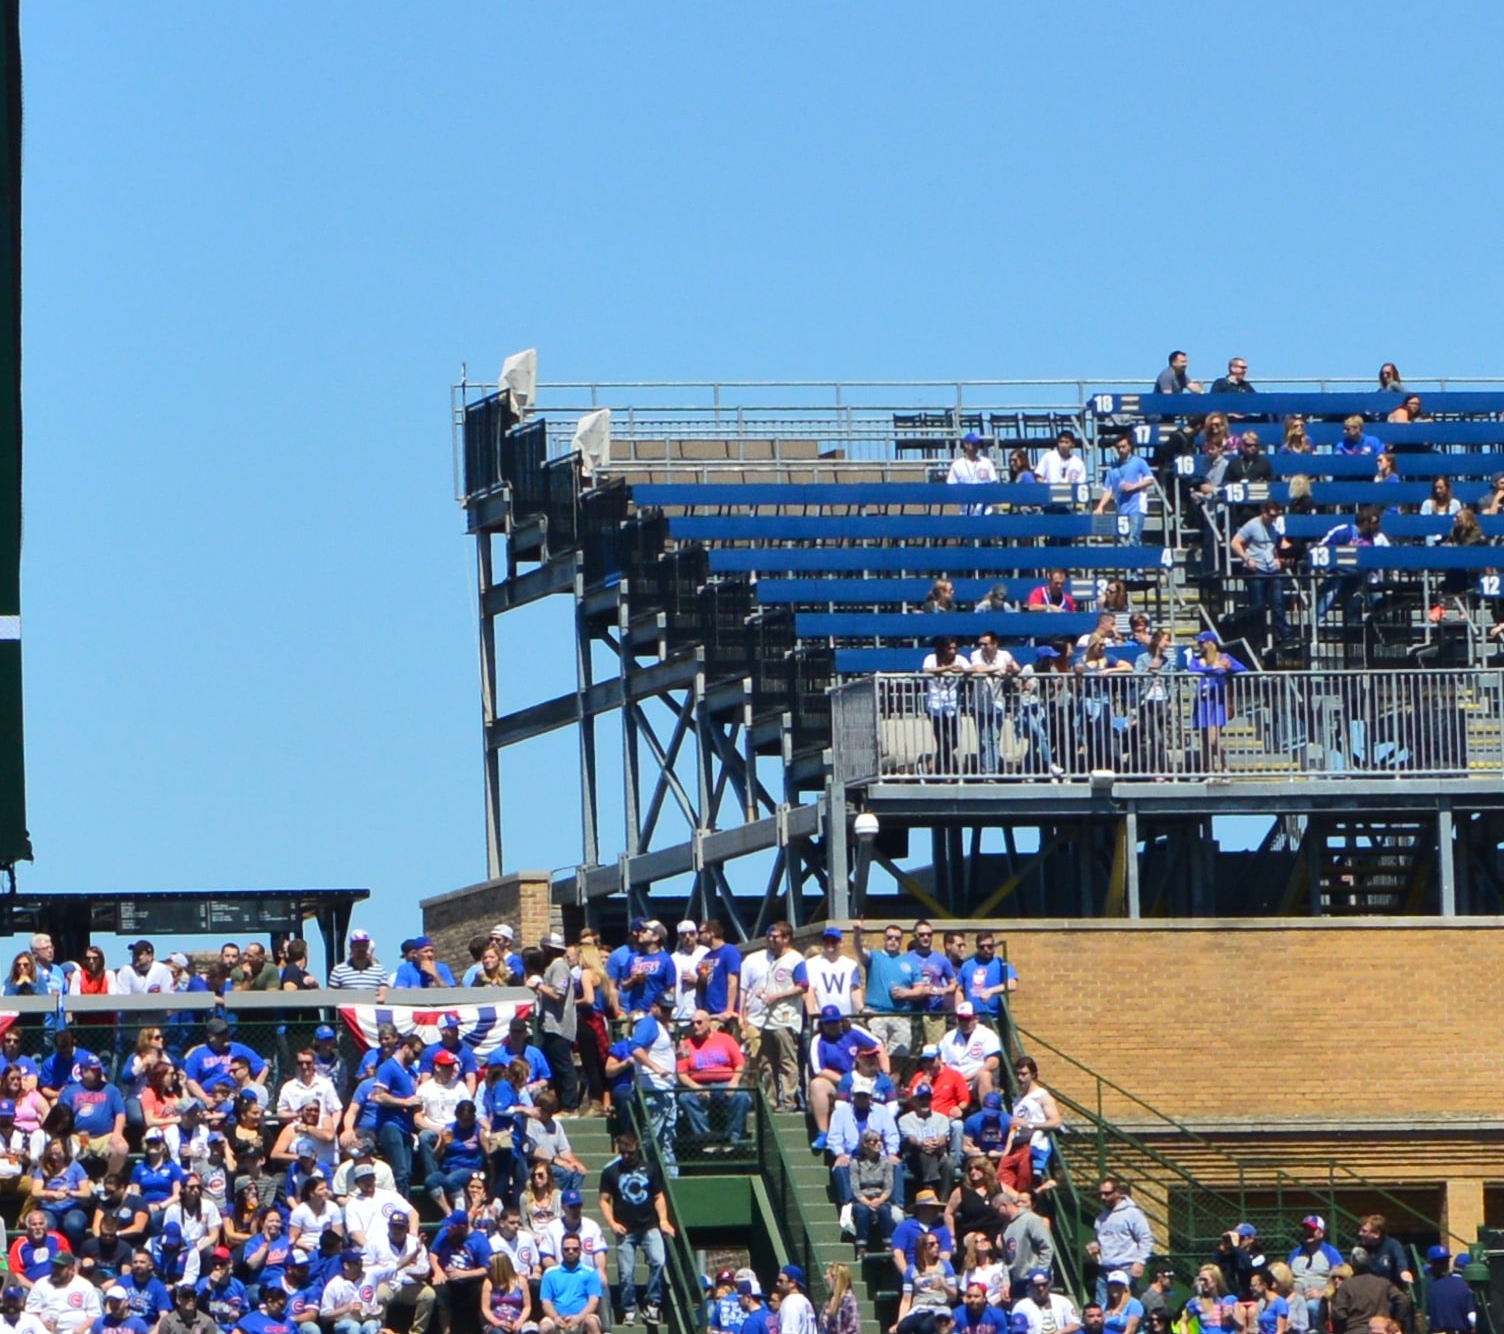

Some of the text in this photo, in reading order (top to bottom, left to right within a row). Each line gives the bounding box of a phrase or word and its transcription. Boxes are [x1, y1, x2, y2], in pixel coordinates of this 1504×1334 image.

[1094, 395, 1113, 413] 18
[1134, 425, 1152, 444] 17
[1175, 456, 1195, 475] 16
[1077, 486, 1090, 503] 6
[1225, 483, 1246, 503] 15
[1118, 516, 1130, 535] 5
[1160, 548, 1173, 567] 4
[1309, 546, 1330, 566] 13
[1480, 575, 1501, 596] 12
[820, 971, 846, 996] W
